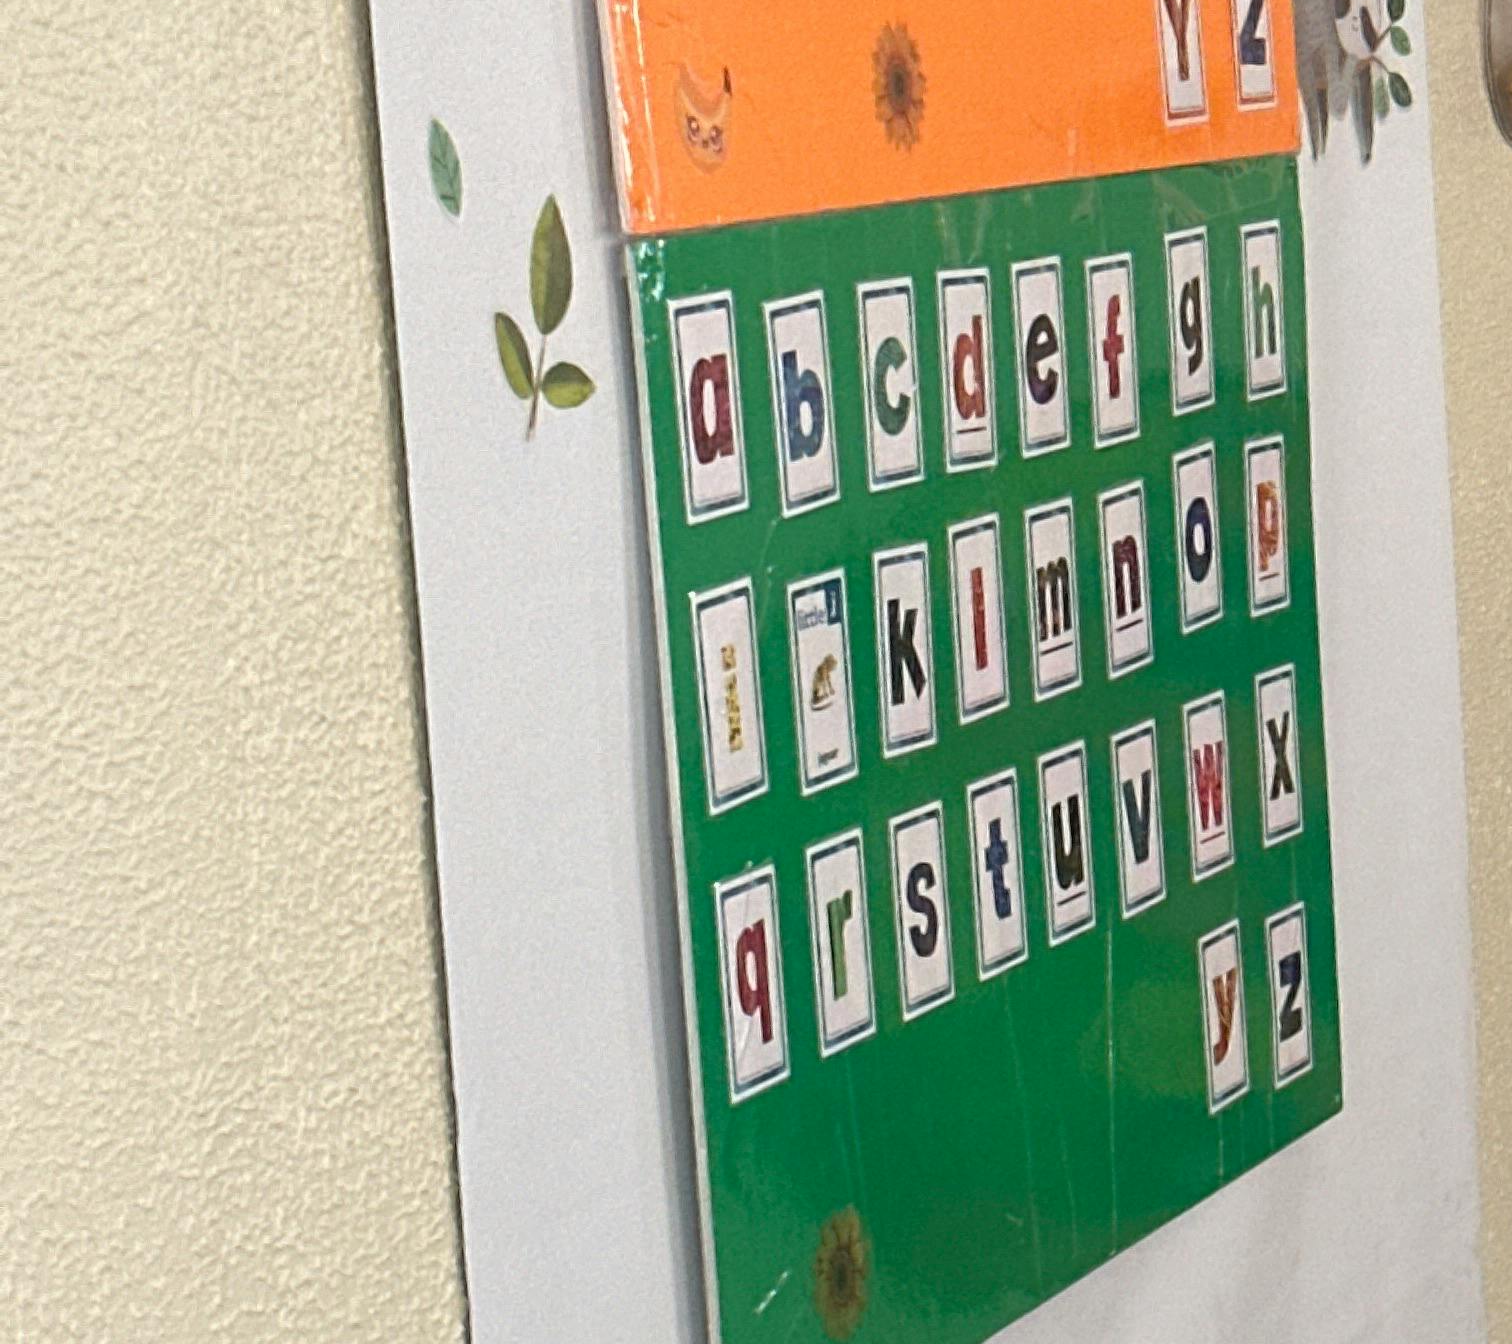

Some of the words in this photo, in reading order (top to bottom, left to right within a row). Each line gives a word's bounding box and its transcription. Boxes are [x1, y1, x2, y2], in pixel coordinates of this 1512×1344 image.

[690, 354, 735, 465] a
[781, 351, 825, 461] b
[873, 336, 912, 436] c
[953, 315, 987, 421] d
[1025, 313, 1059, 405] e
[1103, 294, 1124, 401] f
[1179, 274, 1202, 375] g
[1252, 267, 1277, 359] h
[887, 598, 928, 706] k
[971, 567, 989, 672] l
[1035, 557, 1072, 644] m
[1112, 534, 1143, 619] n
[1185, 496, 1212, 583] o
[1258, 479, 1279, 572] p
[735, 920, 774, 1046] q
[828, 887, 854, 1001] r
[907, 862, 938, 957] s
[986, 818, 1011, 919] t
[1051, 794, 1083, 891] u
[1124, 770, 1151, 864] v
[1194, 740, 1225, 832] w
[1266, 712, 1294, 800] x
[1214, 967, 1238, 1066] y
[1279, 952, 1301, 1042] z
